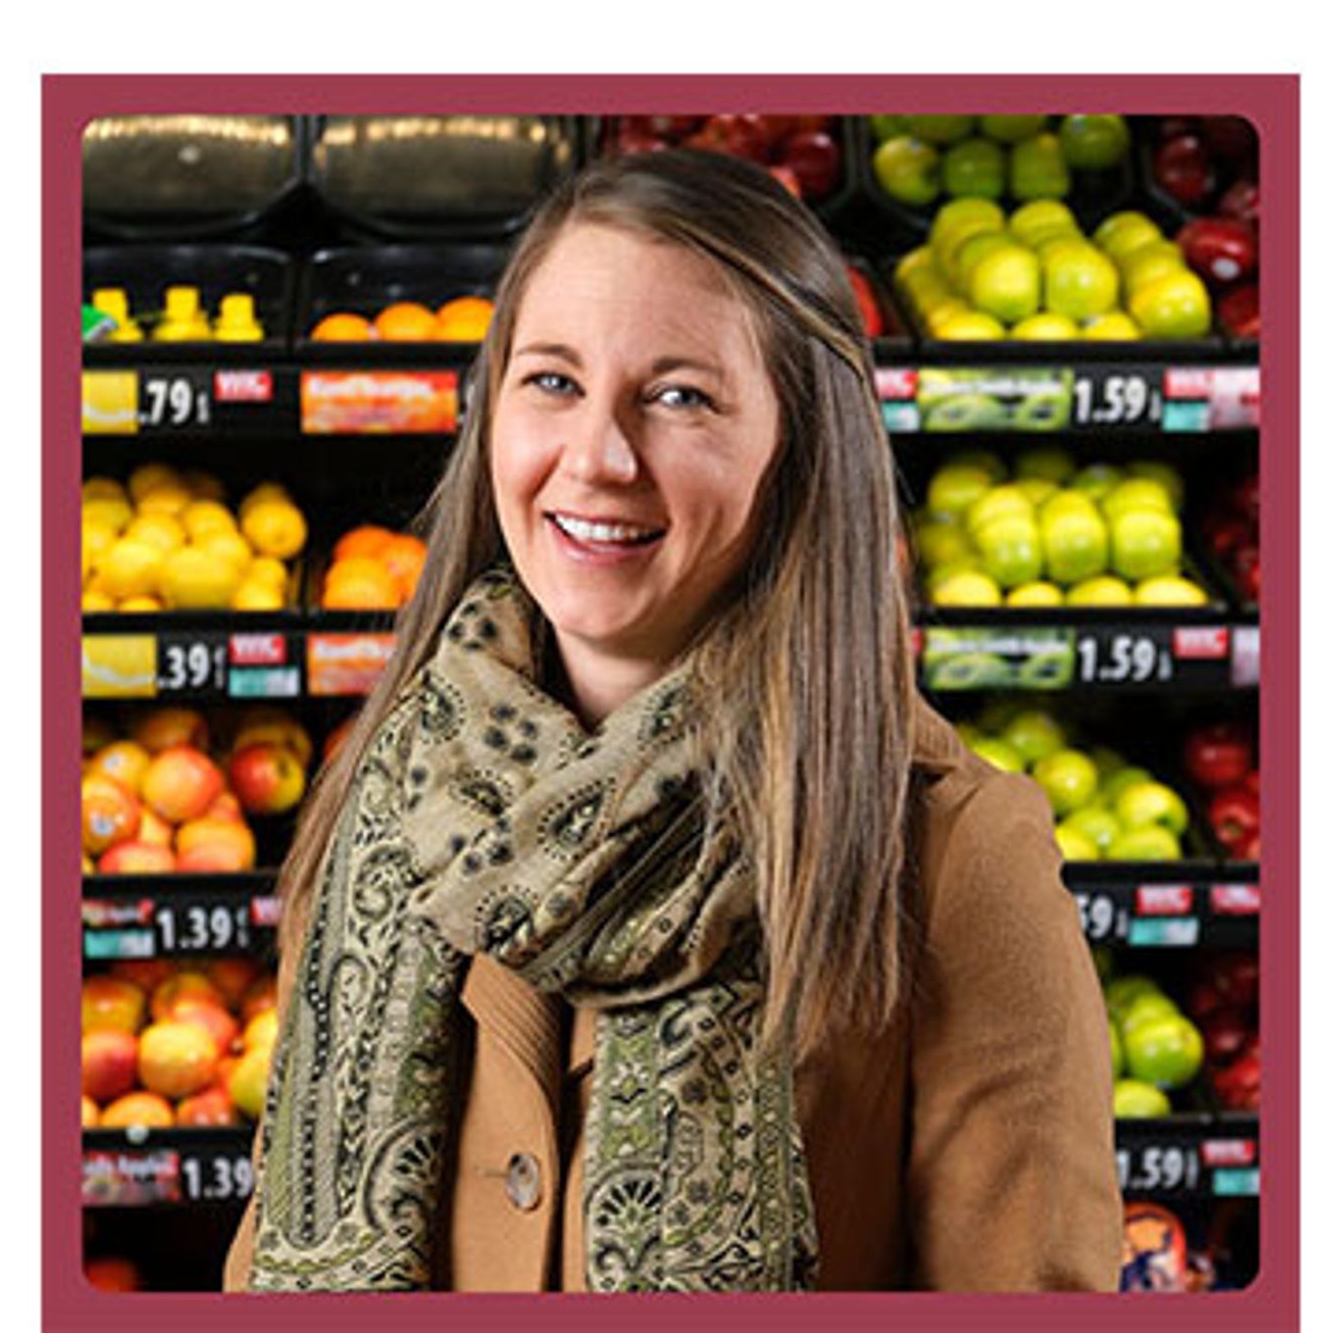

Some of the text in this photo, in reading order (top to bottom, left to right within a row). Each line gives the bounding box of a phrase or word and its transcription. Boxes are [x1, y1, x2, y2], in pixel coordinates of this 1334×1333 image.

[1074, 376, 1148, 425] 1.59
[157, 643, 210, 689] .39
[1078, 636, 1157, 683] 1.59
[157, 906, 233, 950] 1.39
[182, 1156, 254, 1200] 1.39
